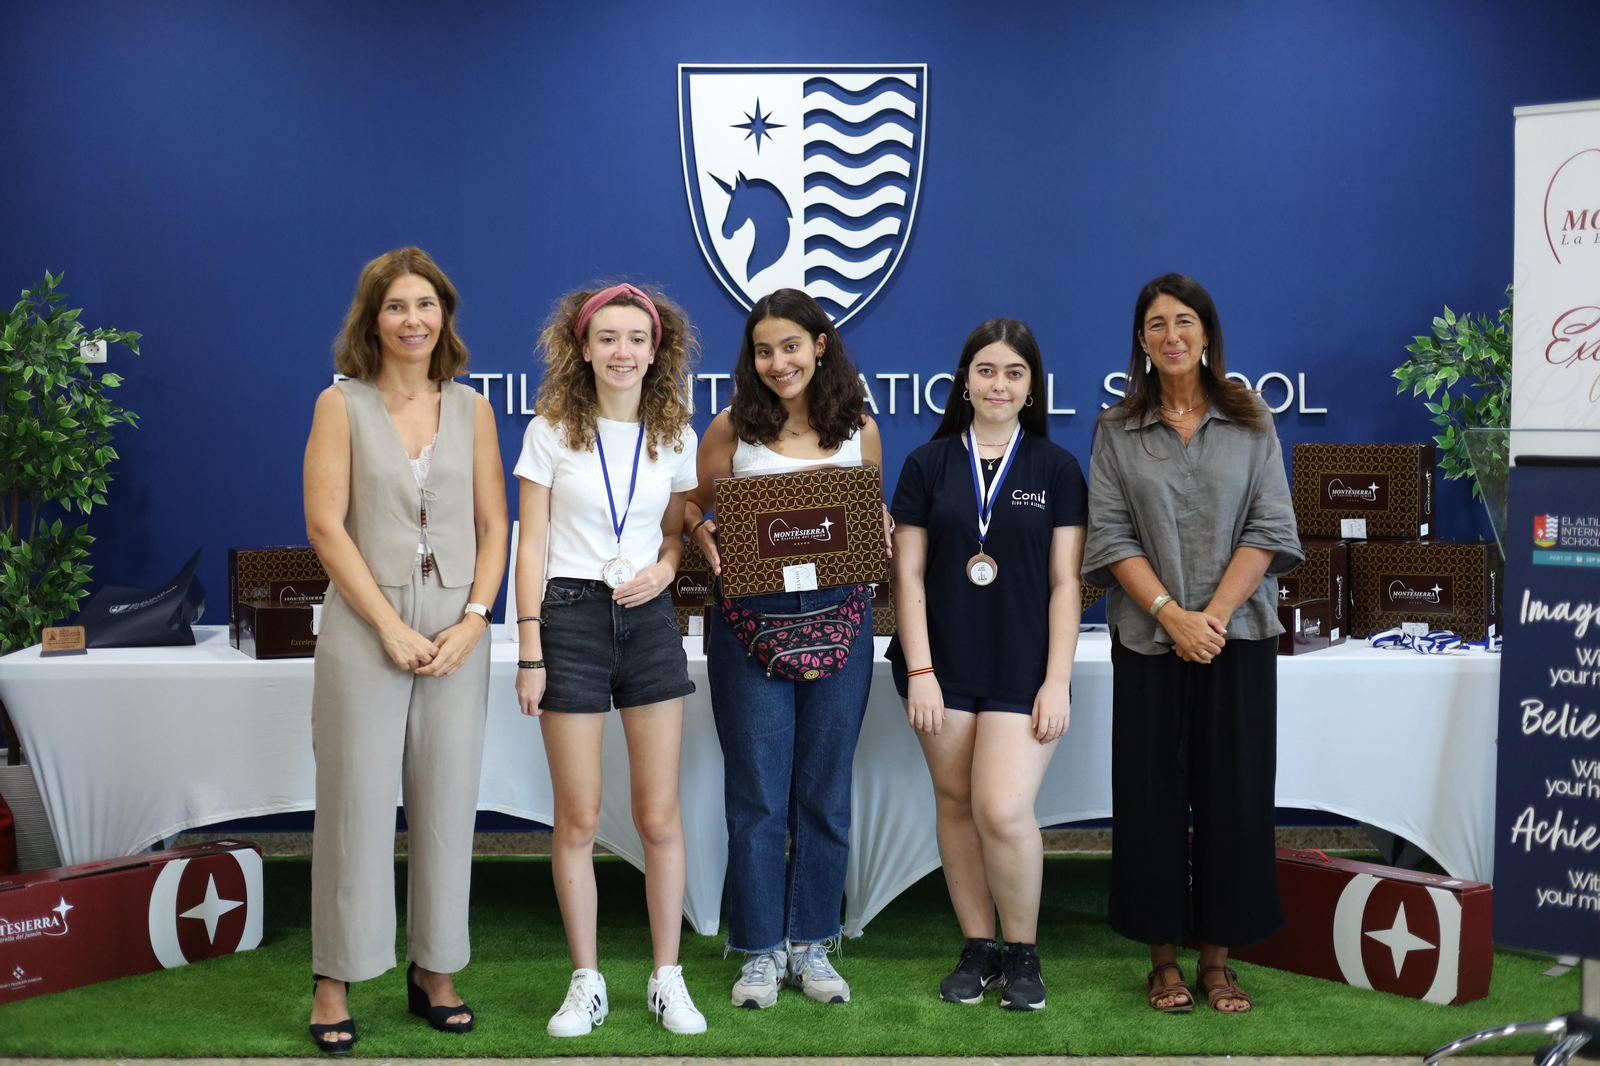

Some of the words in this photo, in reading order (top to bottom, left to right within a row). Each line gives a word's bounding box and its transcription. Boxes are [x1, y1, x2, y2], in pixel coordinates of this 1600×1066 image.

[1561, 234, 1582, 244] La
[1562, 517, 1574, 526] EL
[774, 528, 825, 539] MONTESIERRA
[1520, 588, 1600, 638] Imag
[1550, 668, 1590, 687] your
[1546, 779, 1586, 798] your
[1536, 888, 1577, 907] your
